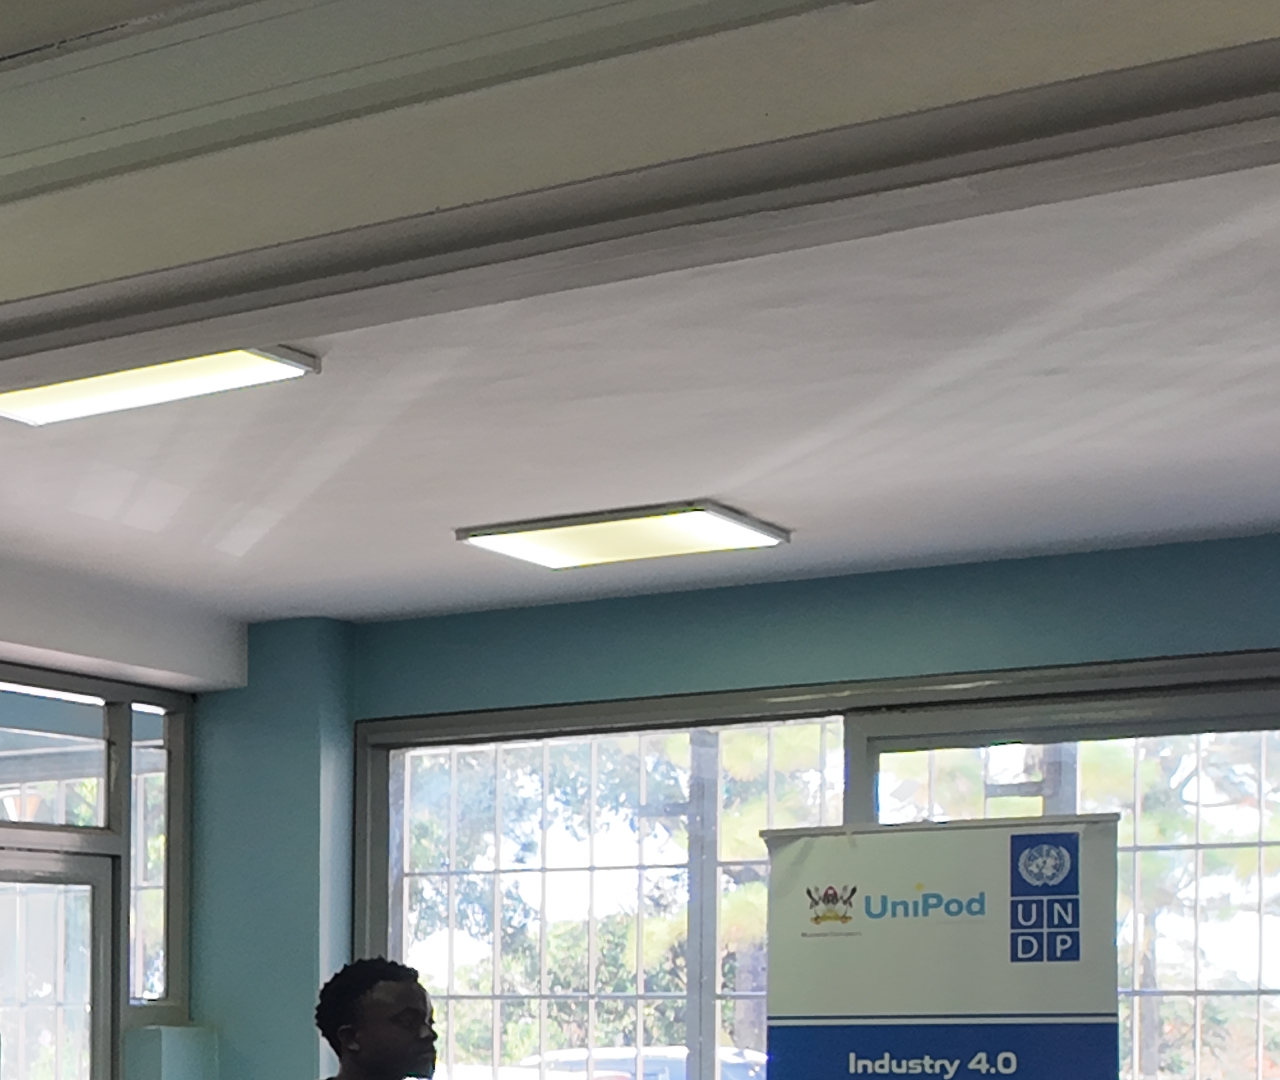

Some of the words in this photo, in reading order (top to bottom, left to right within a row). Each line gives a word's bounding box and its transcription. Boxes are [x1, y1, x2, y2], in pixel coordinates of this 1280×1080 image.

[864, 891, 987, 920] UniPod
[848, 1052, 960, 1079] Industry
[967, 1051, 1018, 1075] 4.0
